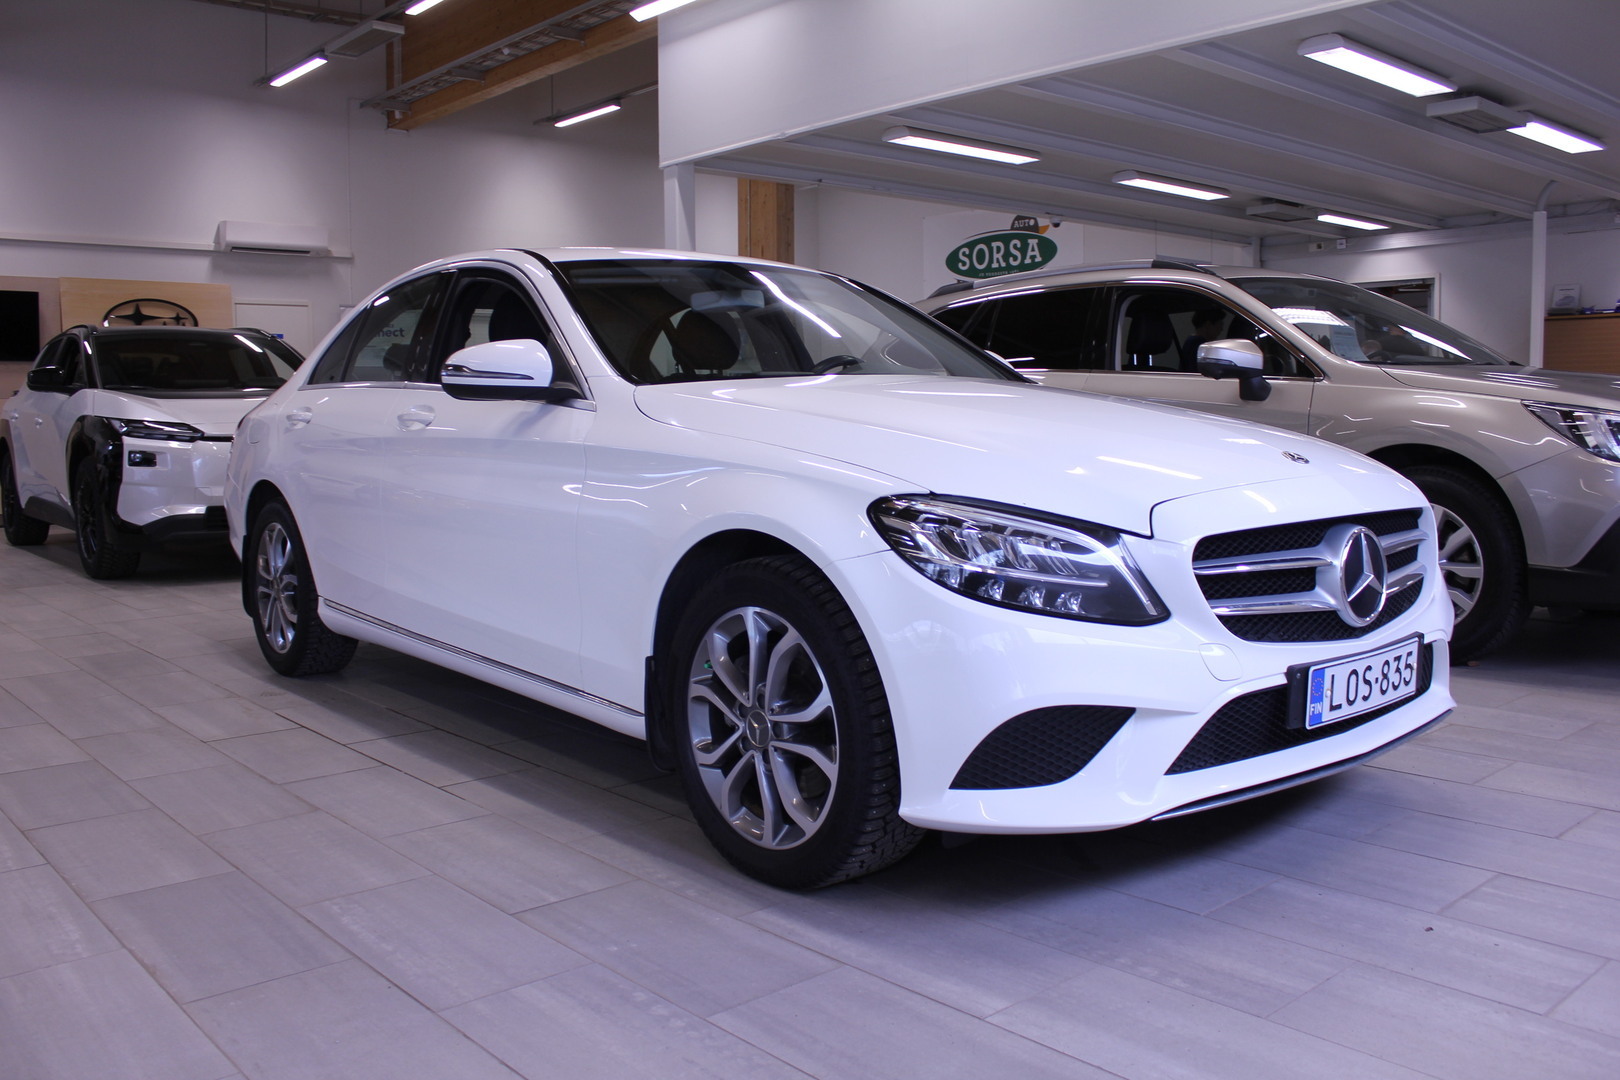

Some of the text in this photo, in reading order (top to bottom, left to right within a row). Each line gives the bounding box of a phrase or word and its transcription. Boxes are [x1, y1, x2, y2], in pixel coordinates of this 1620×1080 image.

[1013, 218, 1035, 228] AUTO
[957, 238, 1042, 271] SORSA
[1309, 701, 1322, 716] FIN
